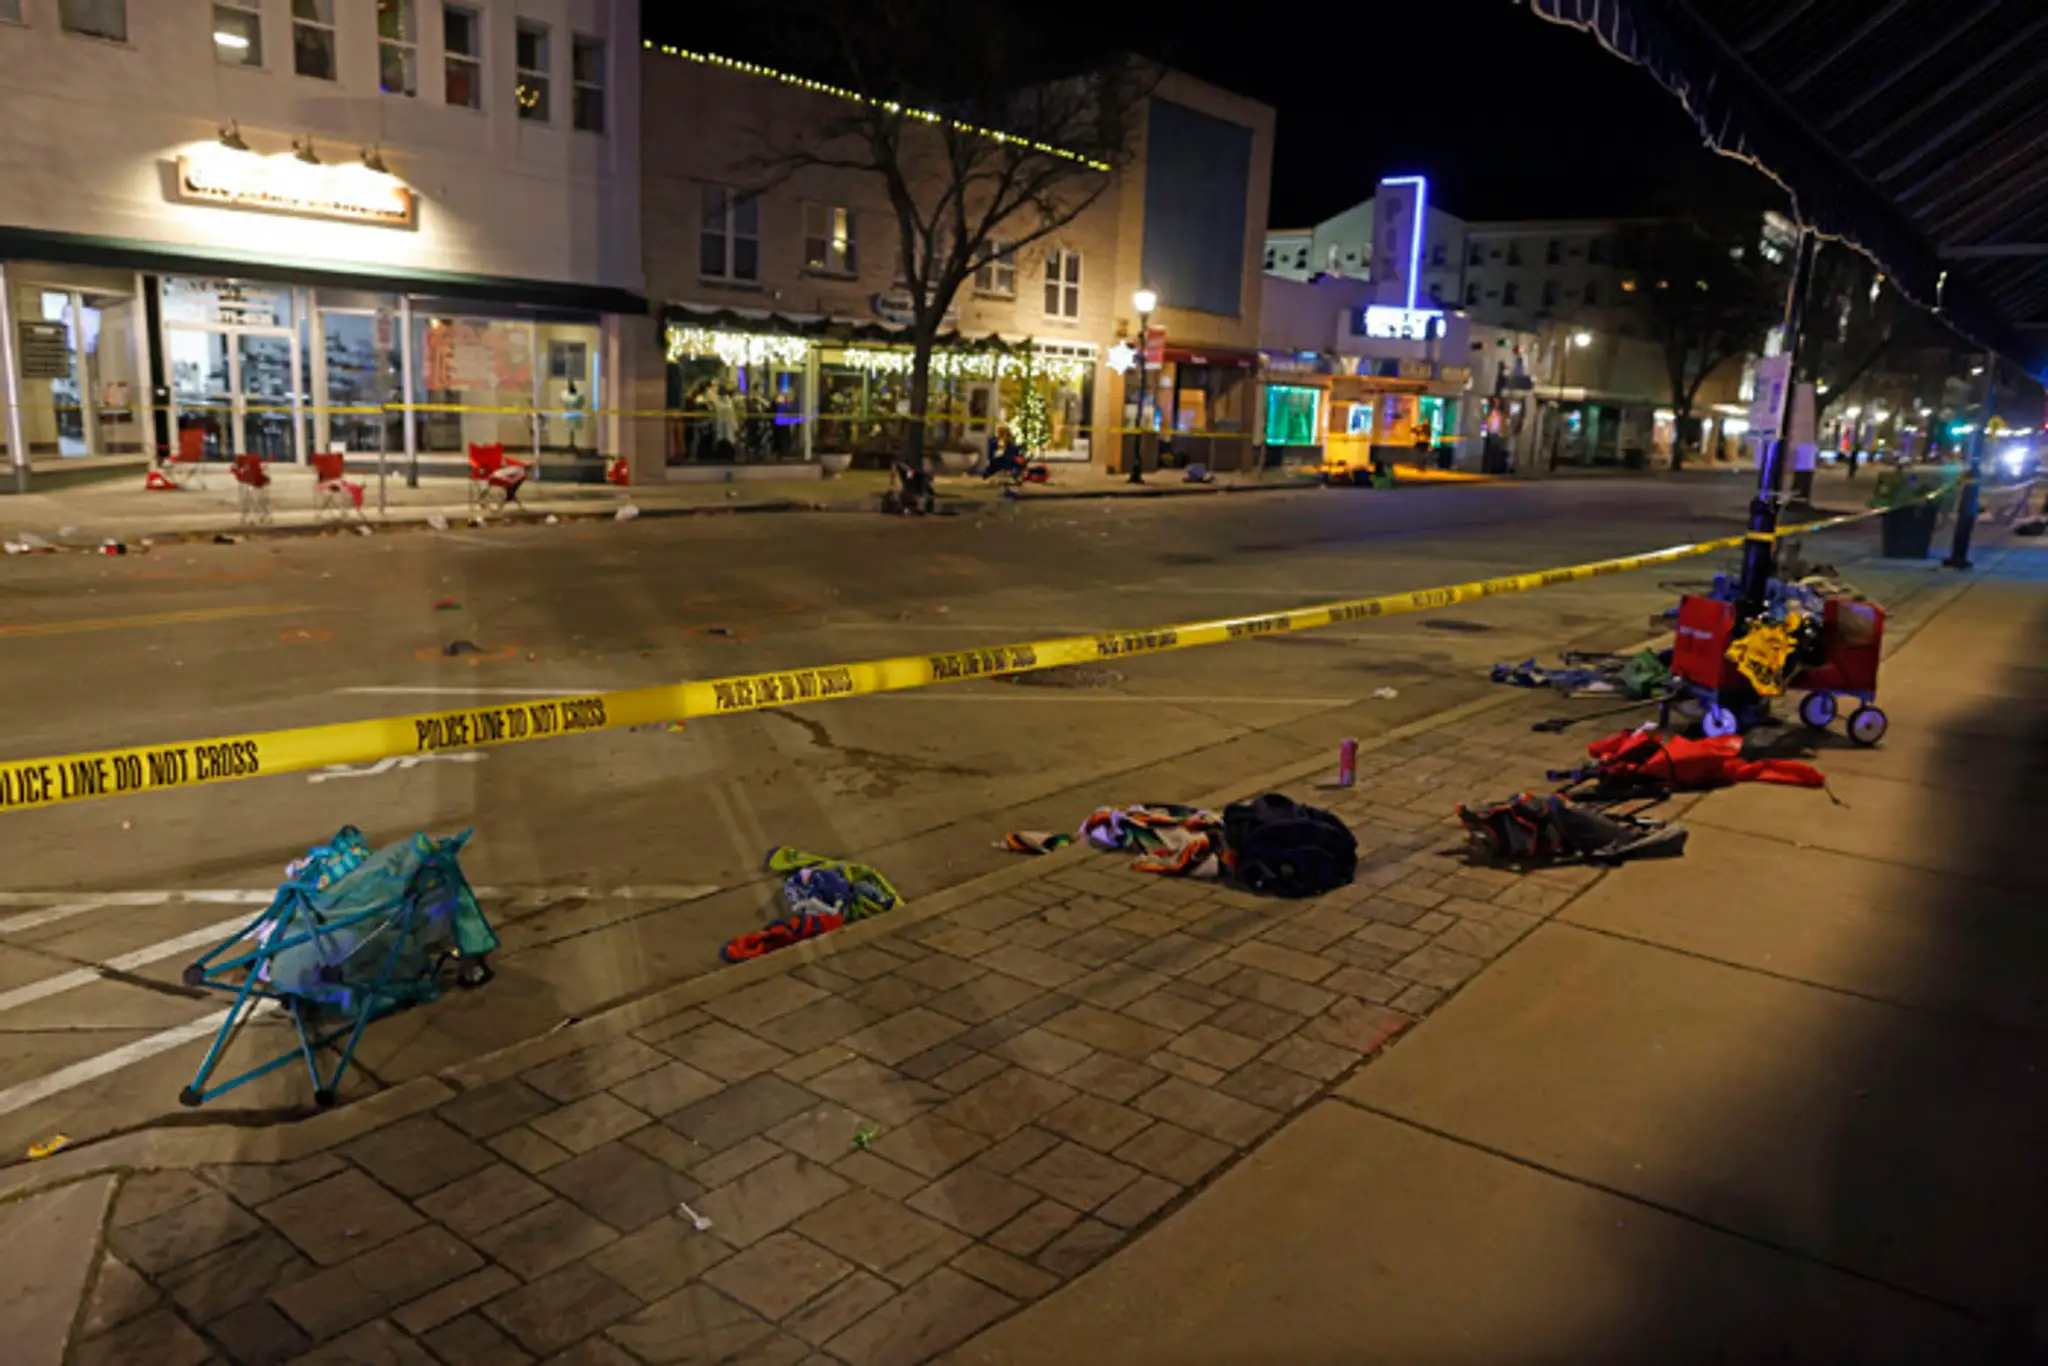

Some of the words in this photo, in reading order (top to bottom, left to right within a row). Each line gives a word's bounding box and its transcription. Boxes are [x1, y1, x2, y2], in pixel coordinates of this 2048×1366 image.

[415, 714, 469, 751] POLICE
[471, 710, 505, 742] LINE
[506, 707, 528, 738] DO
[530, 704, 558, 733] NOT
[562, 697, 606, 730] CROSS
[0, 764, 53, 805] LICE
[58, 757, 109, 798] LINE
[113, 754, 142, 791] DO
[147, 749, 189, 787] NOT
[195, 740, 260, 780] CROSS
